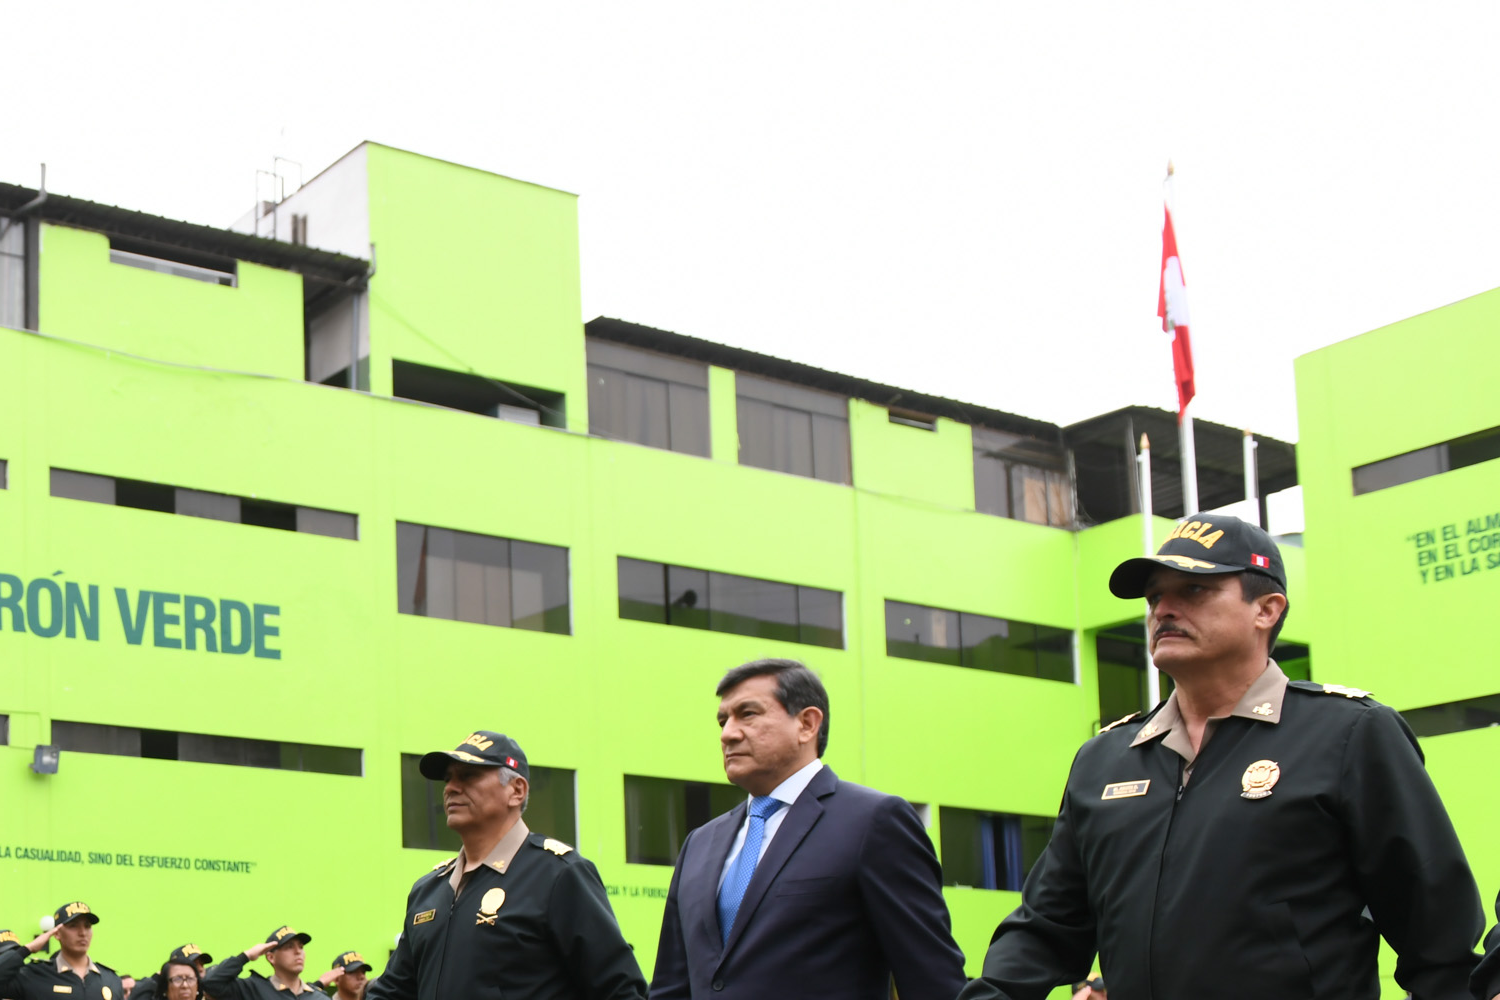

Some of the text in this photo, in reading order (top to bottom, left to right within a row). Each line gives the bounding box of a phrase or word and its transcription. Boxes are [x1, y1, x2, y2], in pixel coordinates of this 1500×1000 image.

[1442, 523, 1461, 542] EL
[1418, 547, 1437, 567] EN
[1444, 543, 1463, 560] EL
[1420, 568, 1430, 585] Y
[1434, 563, 1455, 582] EN
[1460, 558, 1481, 576] LA
[113, 586, 282, 660] VERDE
[15, 847, 84, 865] CASUALIDAD,
[88, 852, 112, 866] SINO
[116, 853, 134, 867] DEL
[139, 855, 191, 870] ESFUERZO
